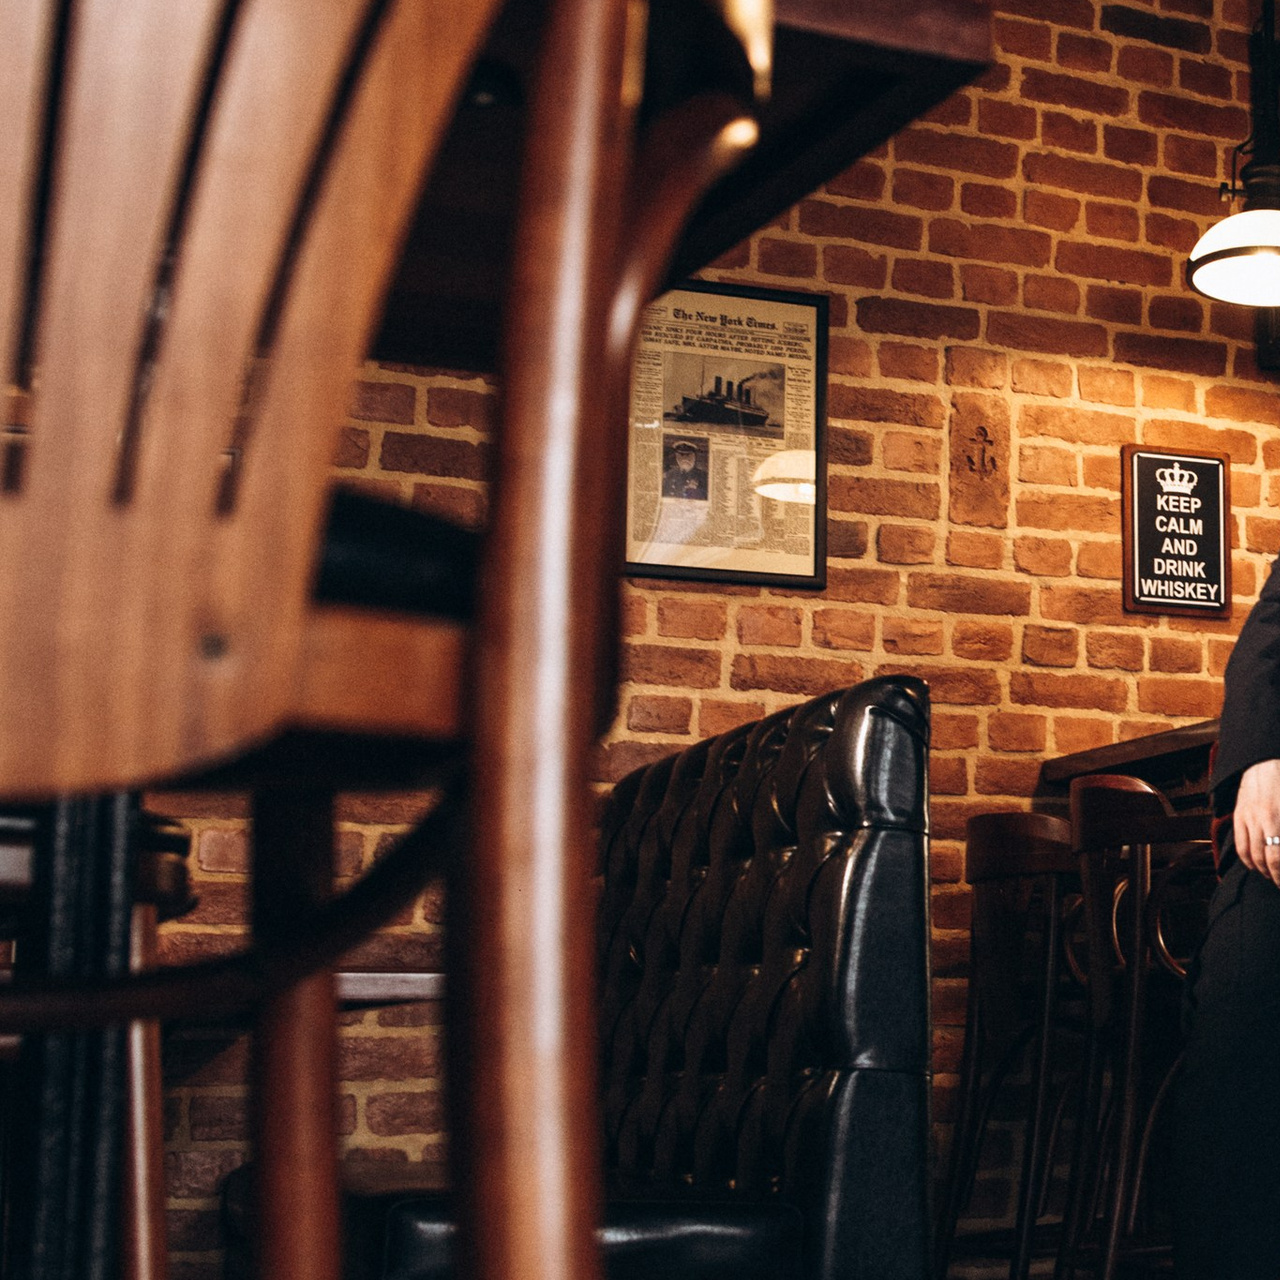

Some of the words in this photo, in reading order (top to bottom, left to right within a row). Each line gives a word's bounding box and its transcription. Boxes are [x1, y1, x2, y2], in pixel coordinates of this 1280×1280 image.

[673, 308, 693, 321] The
[696, 311, 717, 322] New
[719, 314, 743, 326] York
[1156, 494, 1202, 514] KEEP
[1155, 515, 1204, 535] CALM
[1161, 537, 1198, 556] AND
[1153, 558, 1206, 578] DRINK
[1140, 578, 1219, 600] WHISKEY
